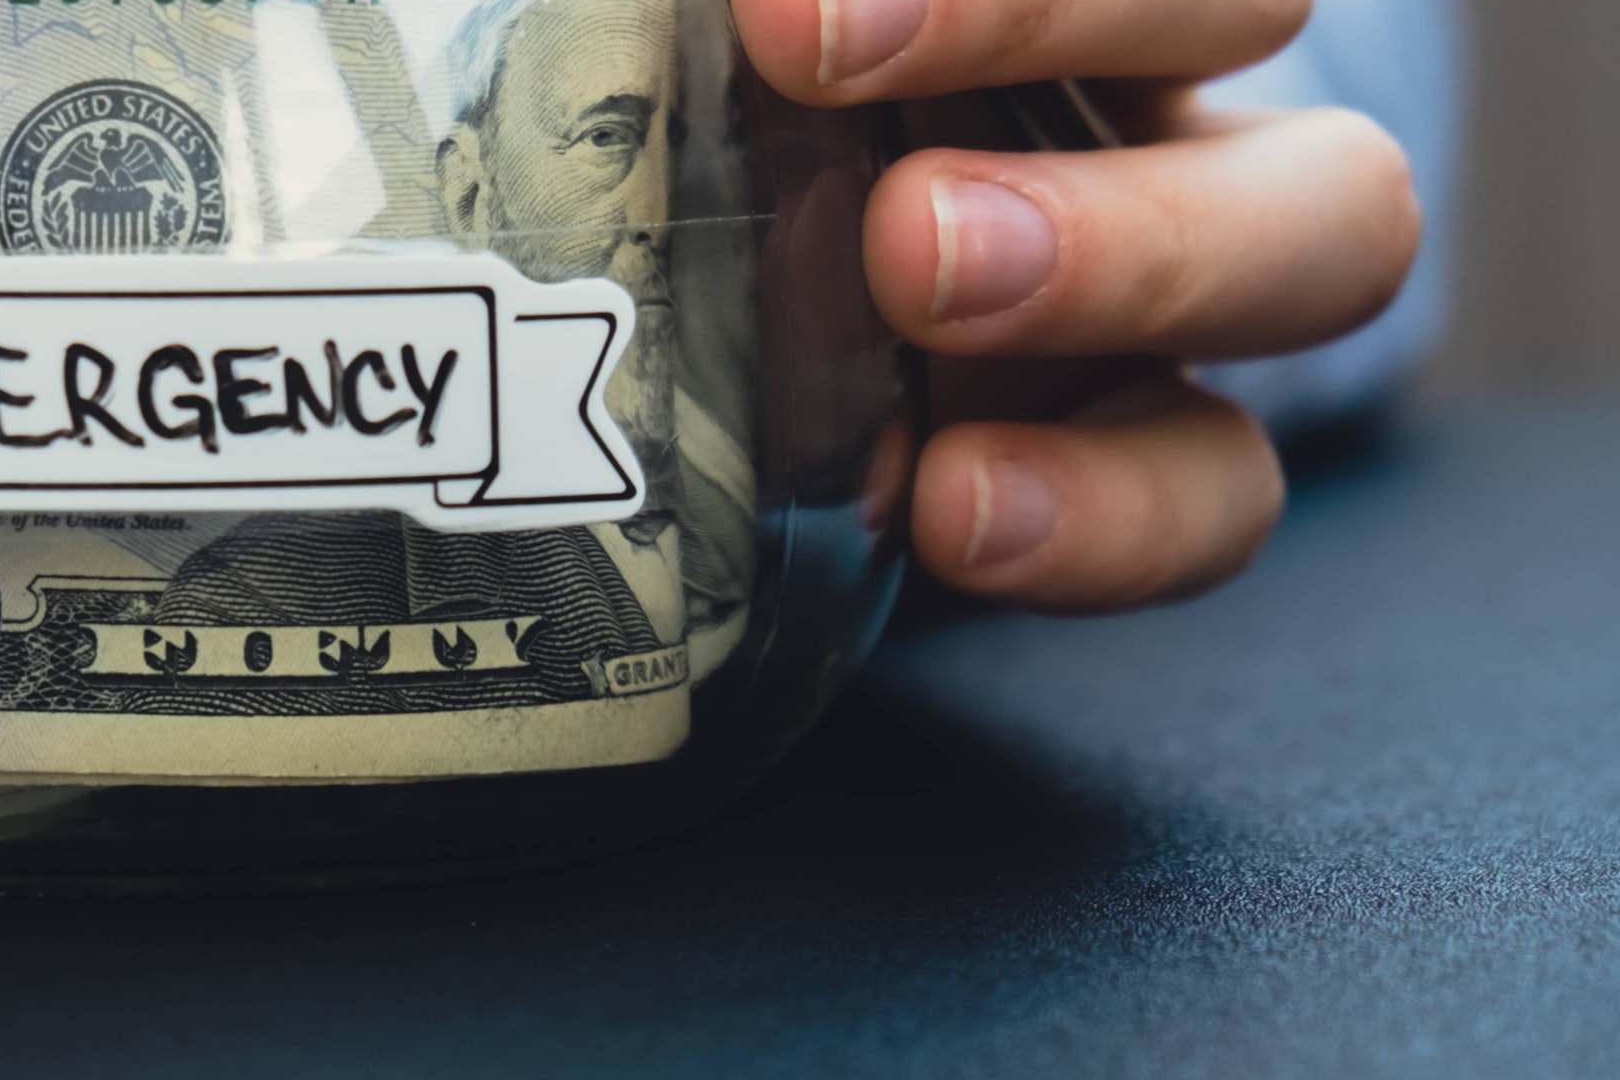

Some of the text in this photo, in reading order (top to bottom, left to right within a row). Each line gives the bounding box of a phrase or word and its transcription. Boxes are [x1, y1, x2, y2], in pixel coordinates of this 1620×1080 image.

[25, 93, 204, 155] UNITED STATES
[191, 173, 223, 252] STEM
[11, 513, 31, 533] of
[33, 512, 61, 527] the
[65, 512, 126, 529] United
[80, 616, 550, 677] FIFTY
